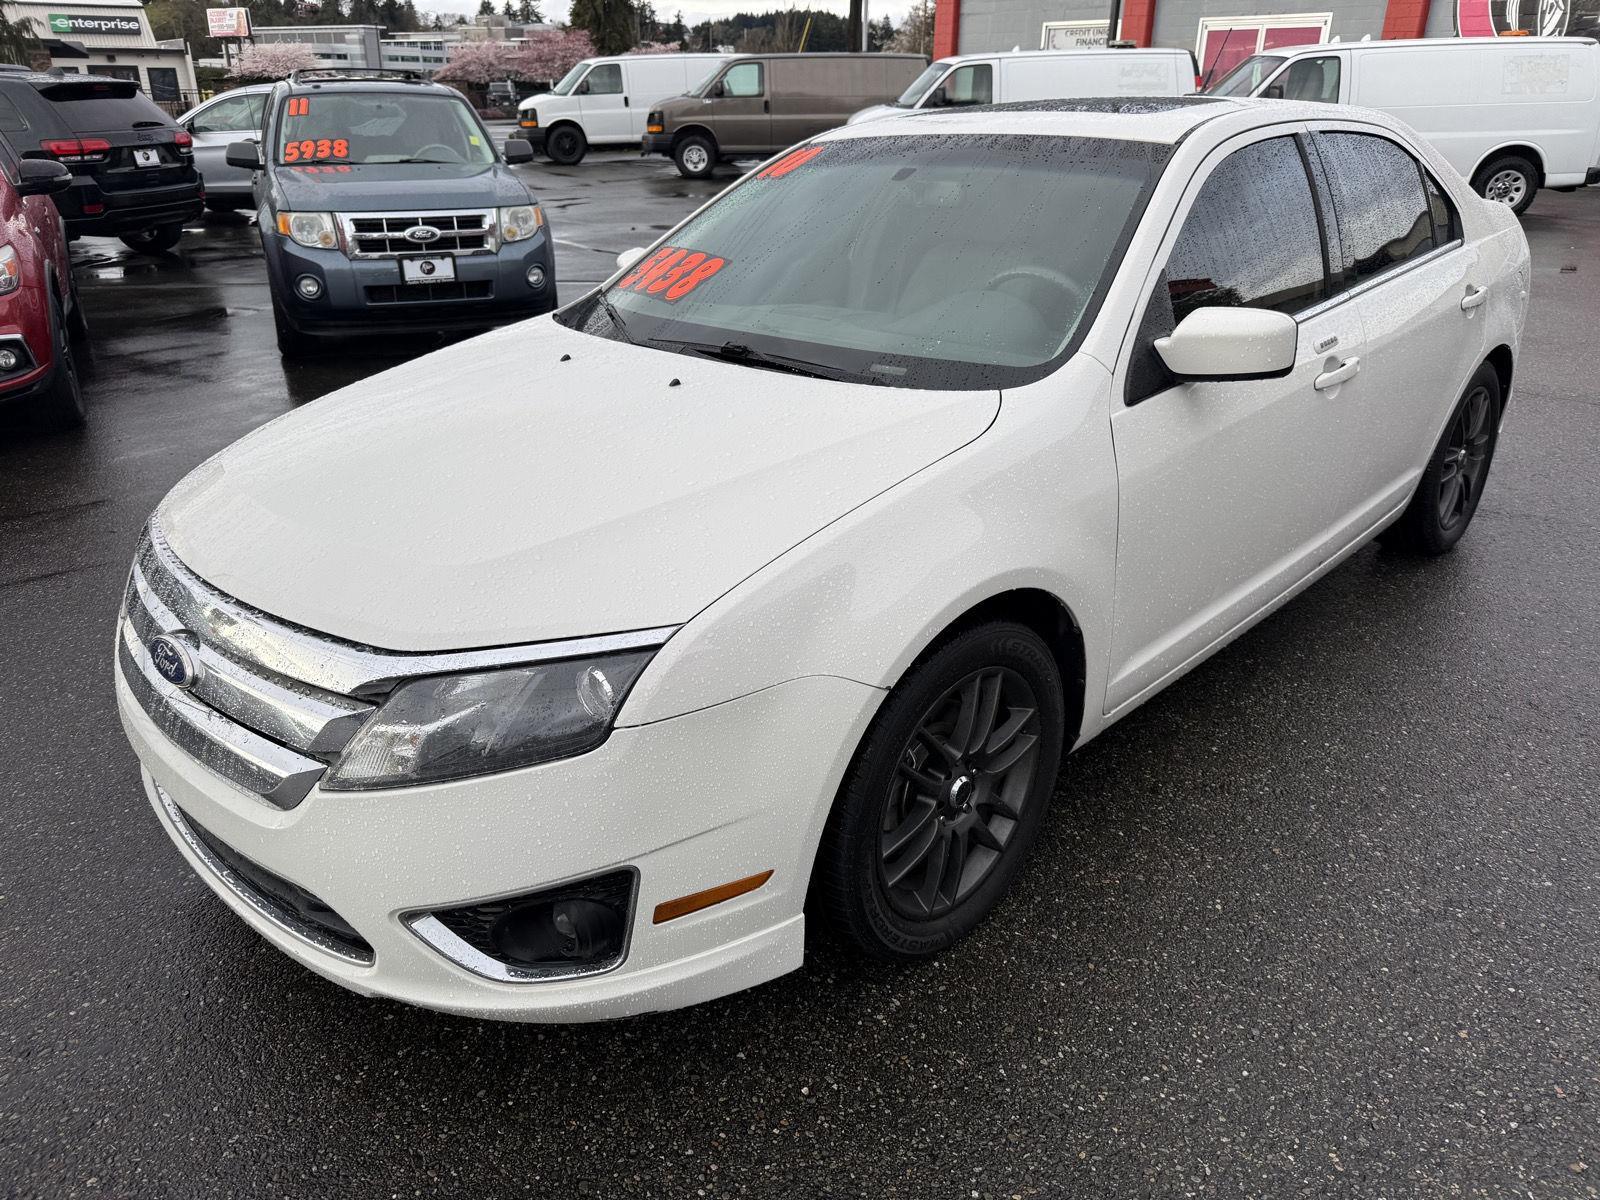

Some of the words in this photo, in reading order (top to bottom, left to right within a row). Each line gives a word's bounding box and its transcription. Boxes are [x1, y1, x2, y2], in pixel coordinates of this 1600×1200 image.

[52, 18, 139, 31] enterprise
[1065, 29, 1091, 37] CREDIT
[1076, 38, 1106, 47] FINANCI
[288, 97, 309, 116] 11
[284, 139, 349, 163] 5938
[154, 642, 179, 678] Ford
